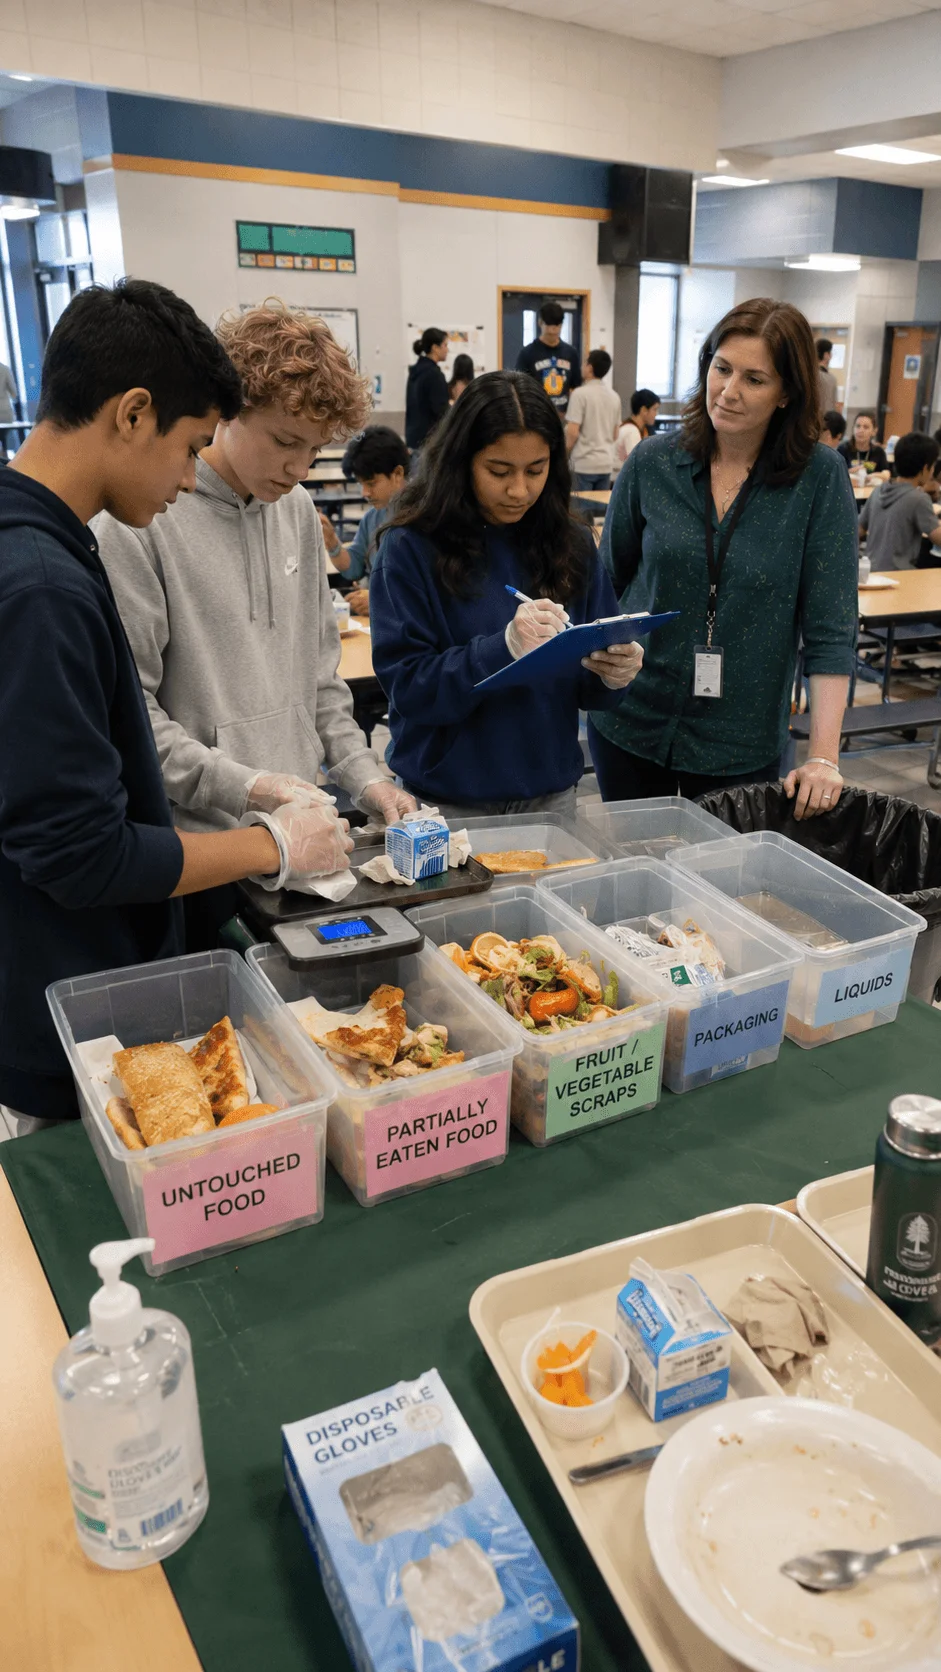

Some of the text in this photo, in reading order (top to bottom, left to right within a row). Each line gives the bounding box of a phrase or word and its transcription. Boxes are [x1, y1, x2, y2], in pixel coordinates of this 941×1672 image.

[834, 972, 893, 1003] LIQUIDS
[694, 1008, 779, 1047] PACKAGING
[575, 1039, 639, 1072] FRUIT /
[555, 1055, 654, 1100] VEGETABLE
[387, 1098, 488, 1142] PARTIALLY
[570, 1083, 637, 1117] SCRAPS
[376, 1120, 497, 1169] EATEN FOOD
[162, 1153, 300, 1207] UNTOUCHED
[204, 1189, 265, 1221] FOOD
[314, 1422, 398, 1464] GLOVES
